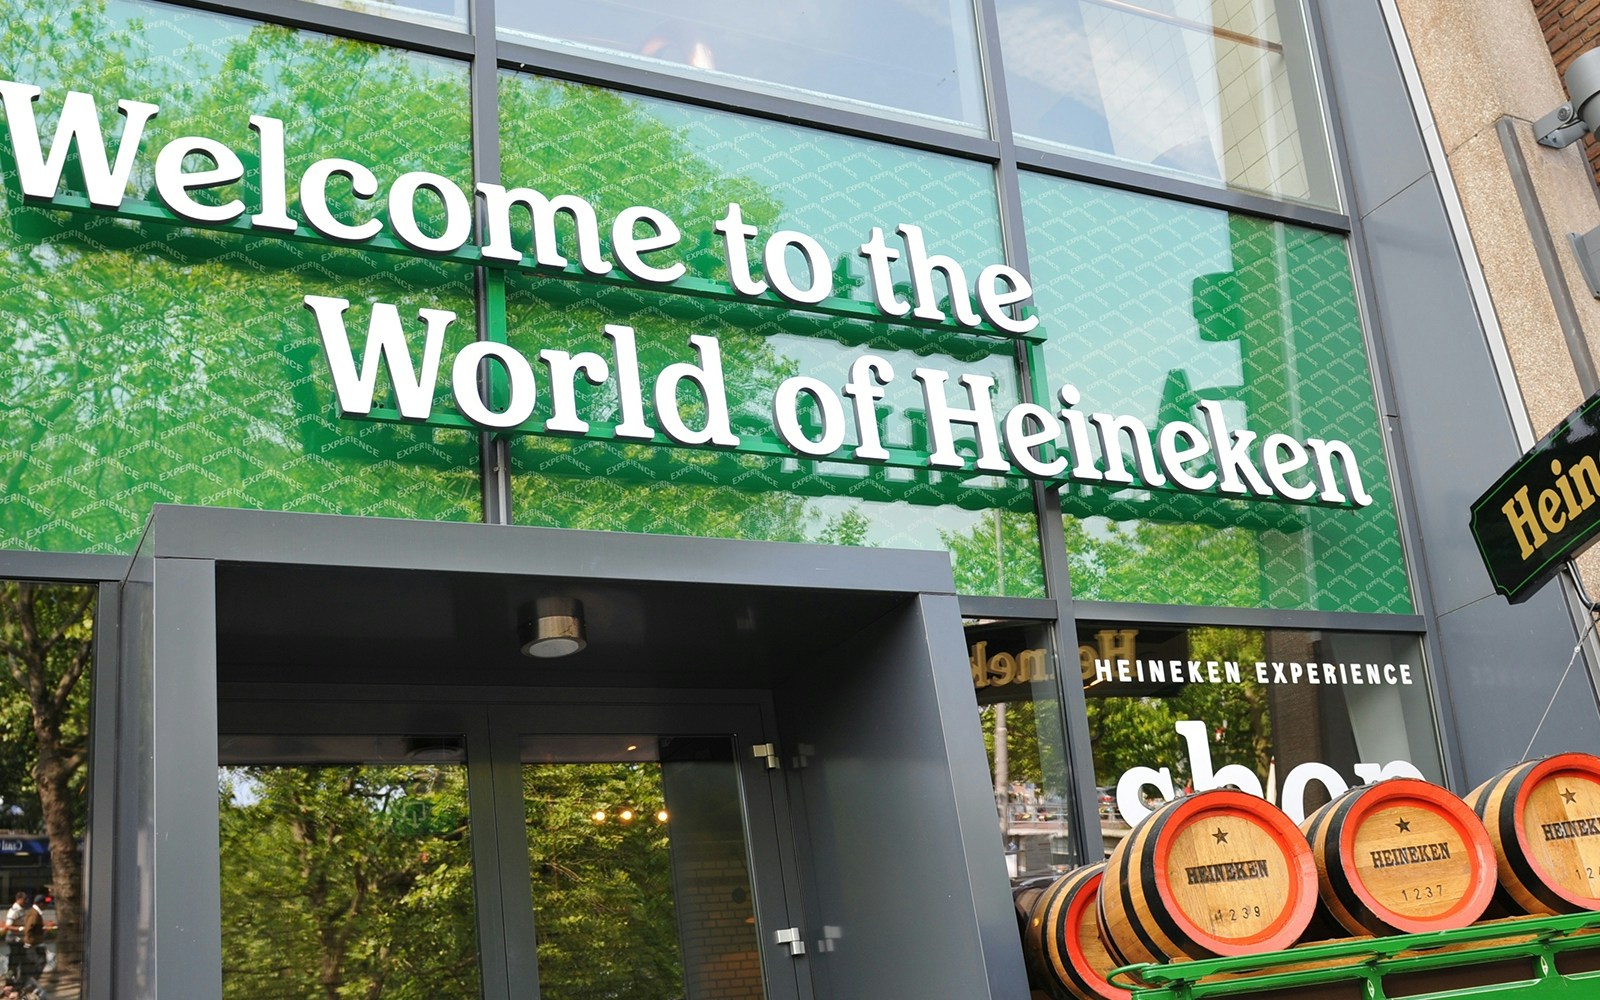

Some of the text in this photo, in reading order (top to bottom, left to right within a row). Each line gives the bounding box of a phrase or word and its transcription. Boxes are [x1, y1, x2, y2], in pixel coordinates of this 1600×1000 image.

[0, 80, 1040, 334] Welcome to the
[304, 294, 1373, 507] World of Heineken
[1094, 659, 1414, 686] HEINEKEN EXPERIENCE
[1370, 842, 1451, 869] HEINEKEN
[1185, 859, 1270, 886] HEINEKEN
